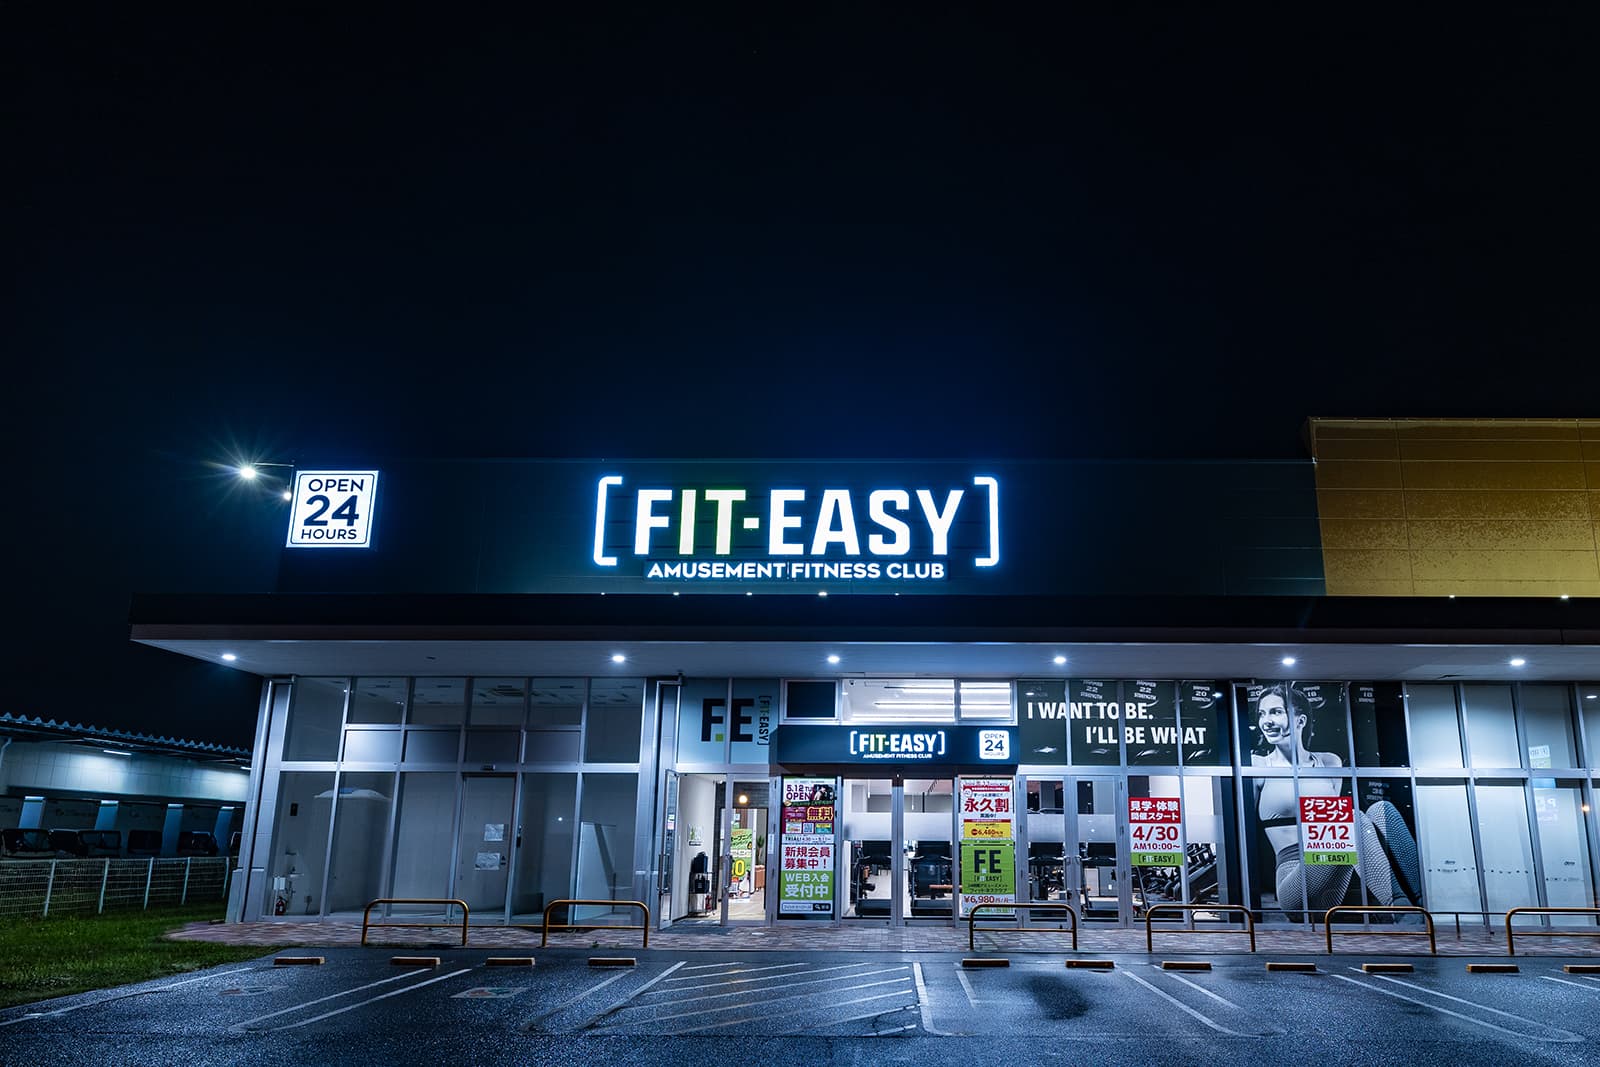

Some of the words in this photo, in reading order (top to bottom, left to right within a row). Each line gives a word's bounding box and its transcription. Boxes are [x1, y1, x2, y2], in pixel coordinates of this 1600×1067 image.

[308, 478, 364, 492] OPEN
[303, 494, 360, 527] 24
[301, 528, 358, 540] HOURS
[646, 562, 787, 579] AMUSEMENT
[790, 562, 881, 579] FITNESS
[885, 562, 945, 579] CLUB
[1027, 702, 1034, 719] I
[1038, 702, 1093, 720] WANT
[1097, 702, 1120, 720] TO
[1125, 702, 1154, 720] BE.
[1086, 726, 1118, 744] I'LL
[1124, 726, 1146, 744] BE
[1150, 727, 1207, 745] WHAT
[984, 739, 1005, 751] 24
[786, 784, 804, 792] 5.12
[786, 792, 811, 801] OPEN
[964, 797, 1009, 813] 永久割
[1303, 799, 1348, 810] グランド
[806, 806, 833, 821] 無料
[1304, 810, 1349, 821] オープン
[1132, 825, 1179, 842] 4/30
[1307, 825, 1350, 841] 5/12
[785, 846, 831, 858] 新規会員
[784, 883, 829, 898] 受付中
